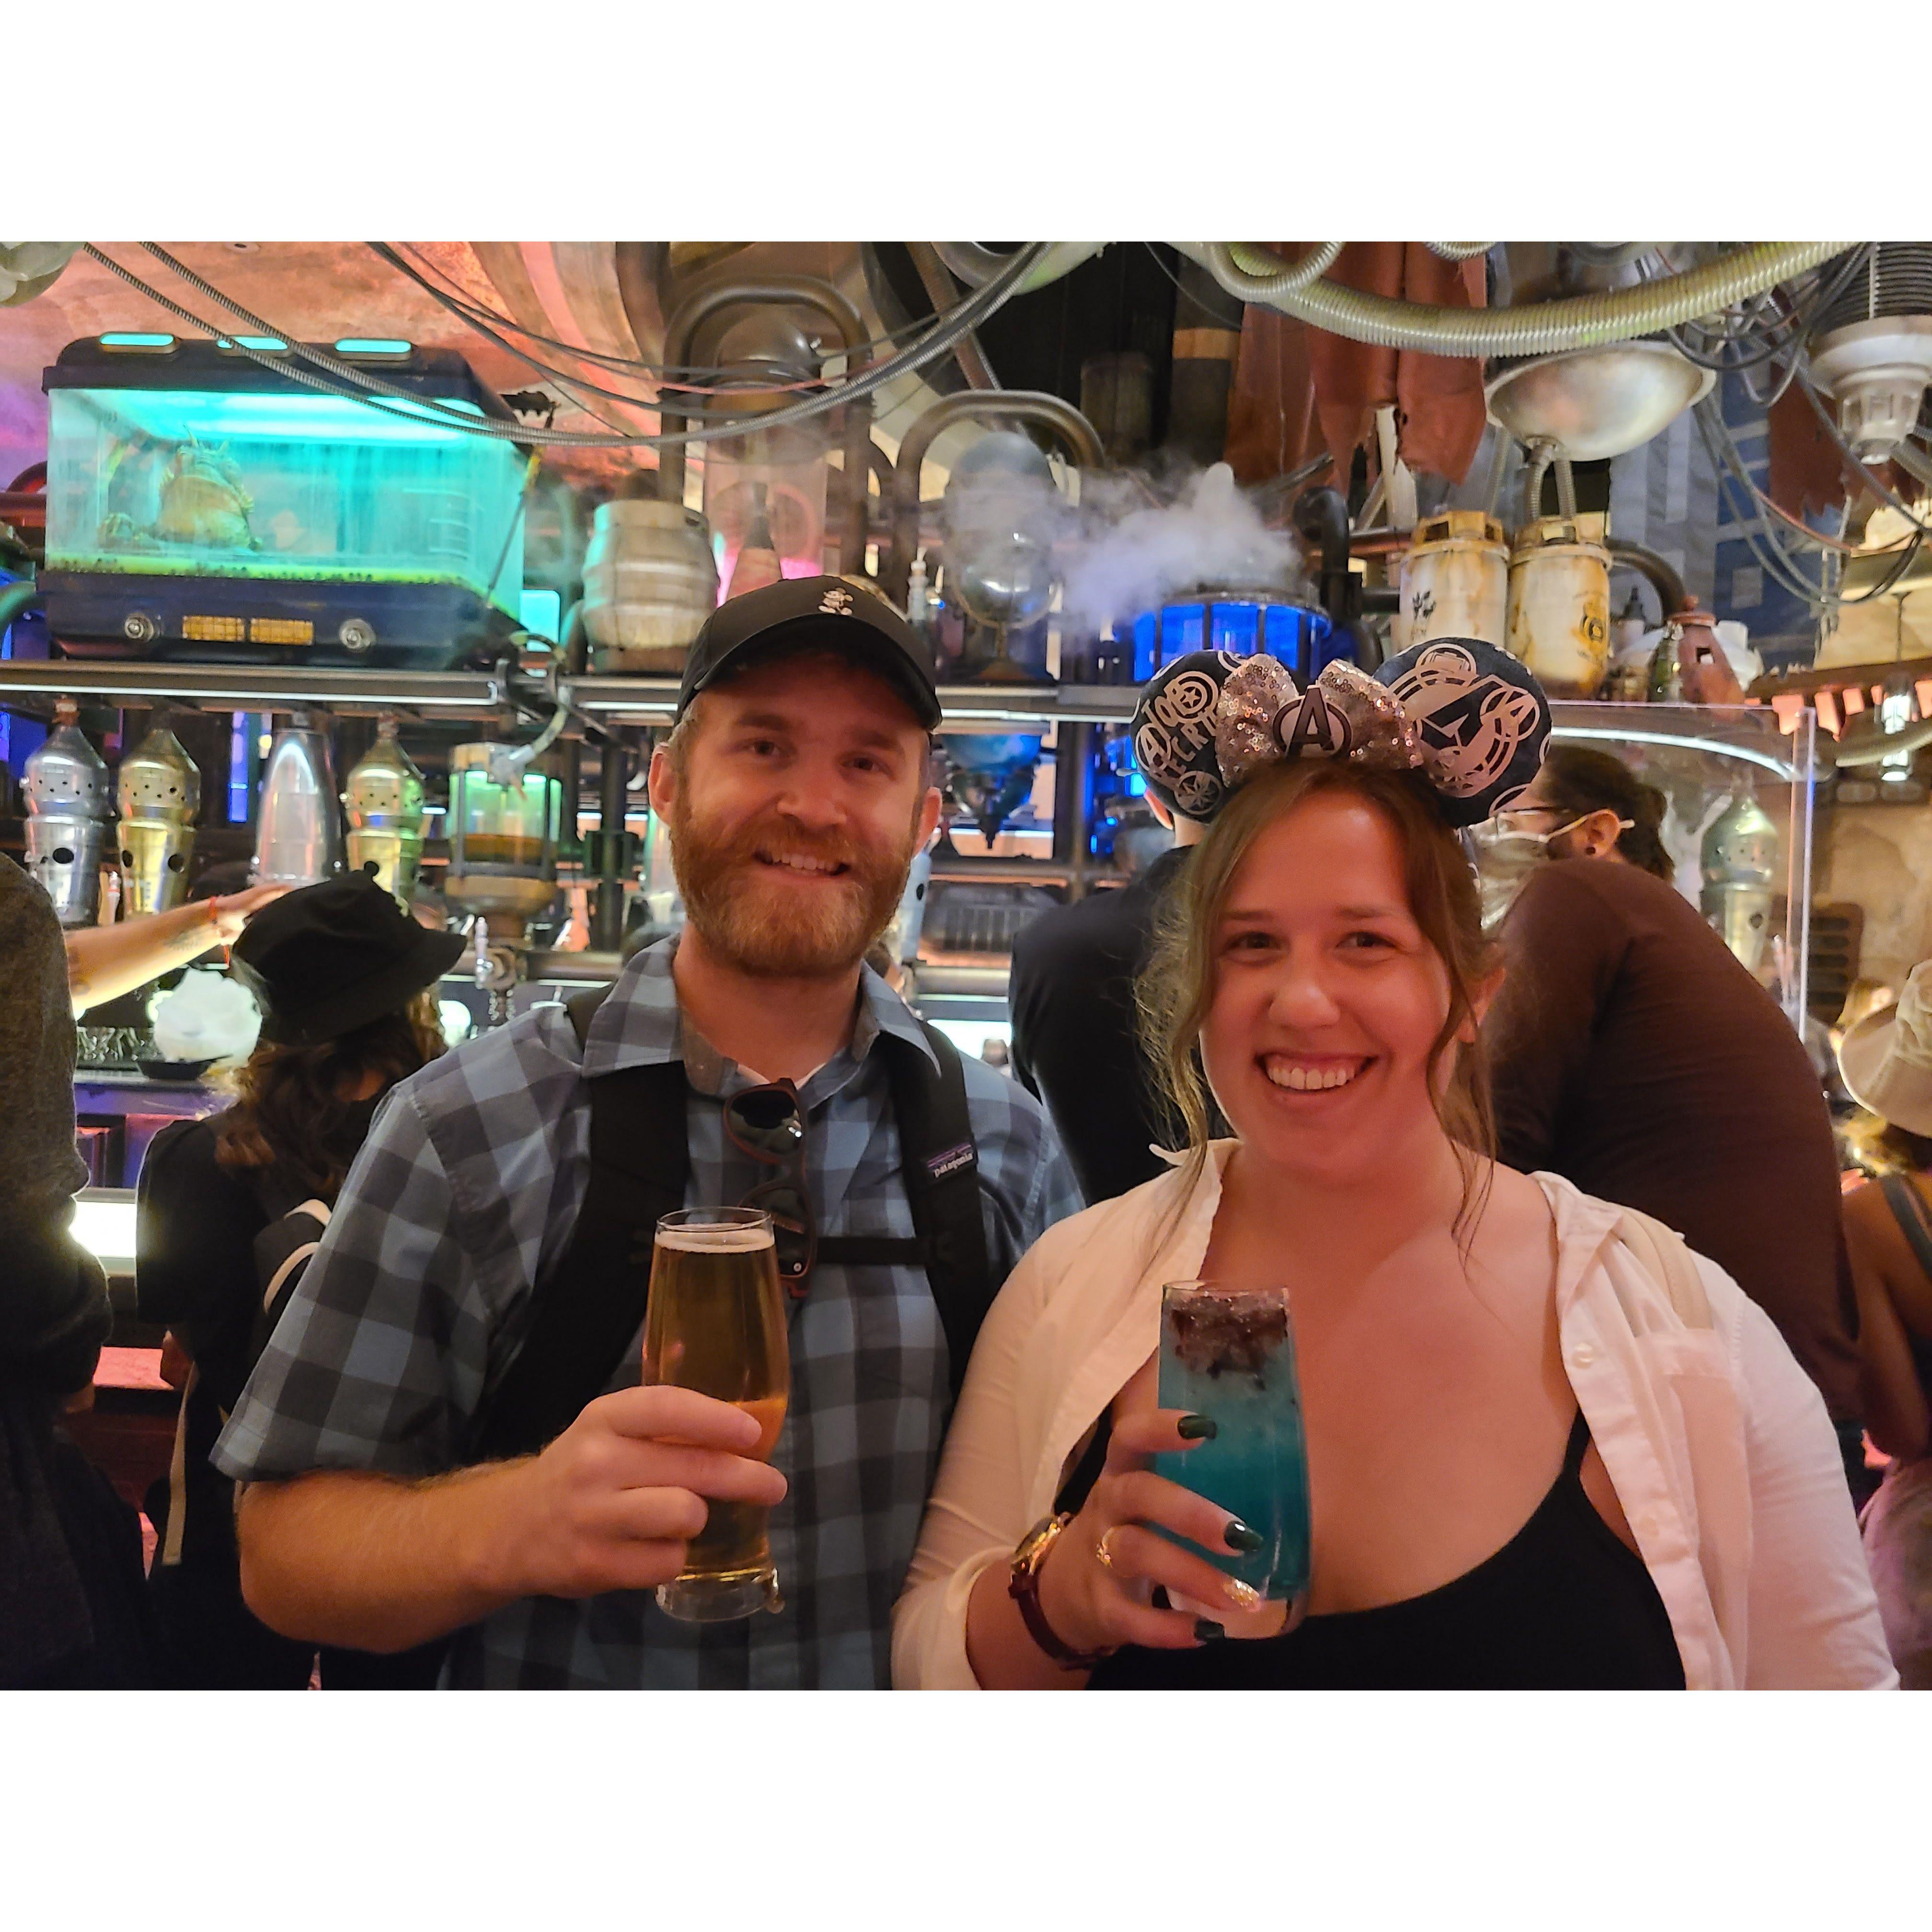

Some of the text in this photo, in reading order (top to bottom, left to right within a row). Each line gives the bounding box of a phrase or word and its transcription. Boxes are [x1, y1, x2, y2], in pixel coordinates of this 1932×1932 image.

[1141, 678, 1187, 740] TOP
[1287, 685, 1335, 754] A
[1148, 702, 1218, 794] RECRU
[934, 1152, 973, 1178] patagonia
